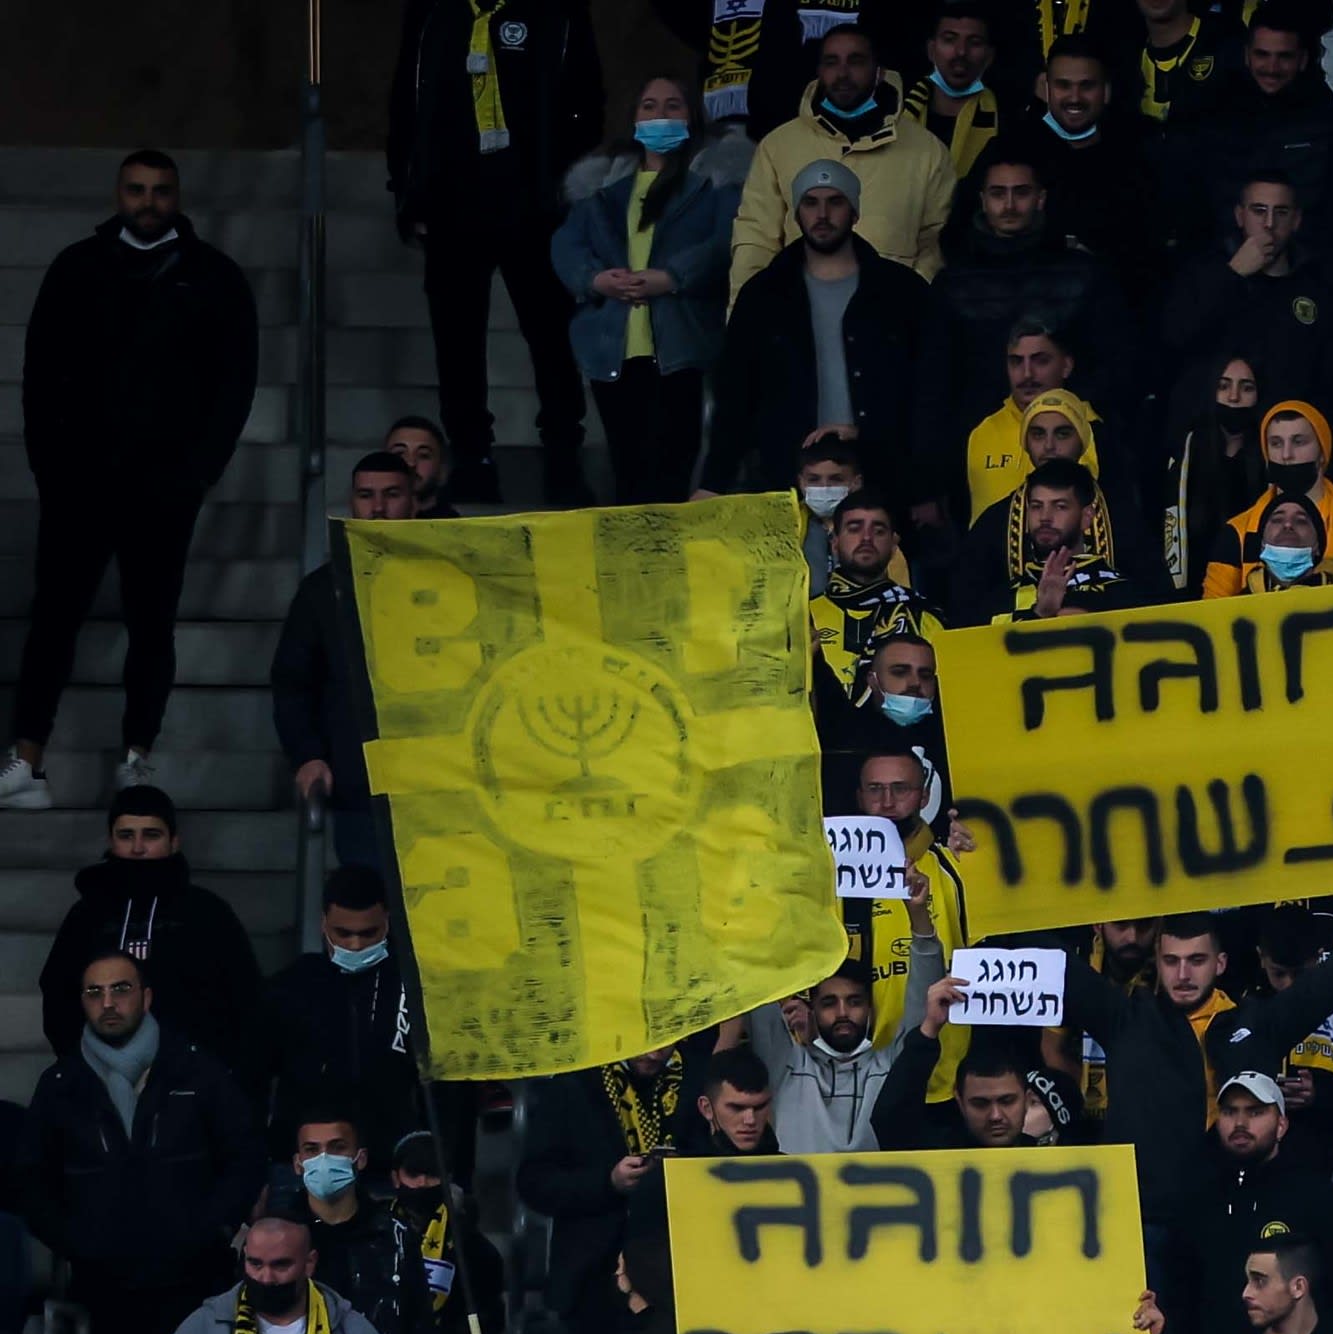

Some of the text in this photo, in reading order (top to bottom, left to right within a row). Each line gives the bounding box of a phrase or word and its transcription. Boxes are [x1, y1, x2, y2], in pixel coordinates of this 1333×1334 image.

[838, 862, 907, 889] תשח
[978, 960, 1038, 984] חוגג
[961, 992, 1060, 1017] תשחרר
[710, 1161, 1099, 1266] חוגג
